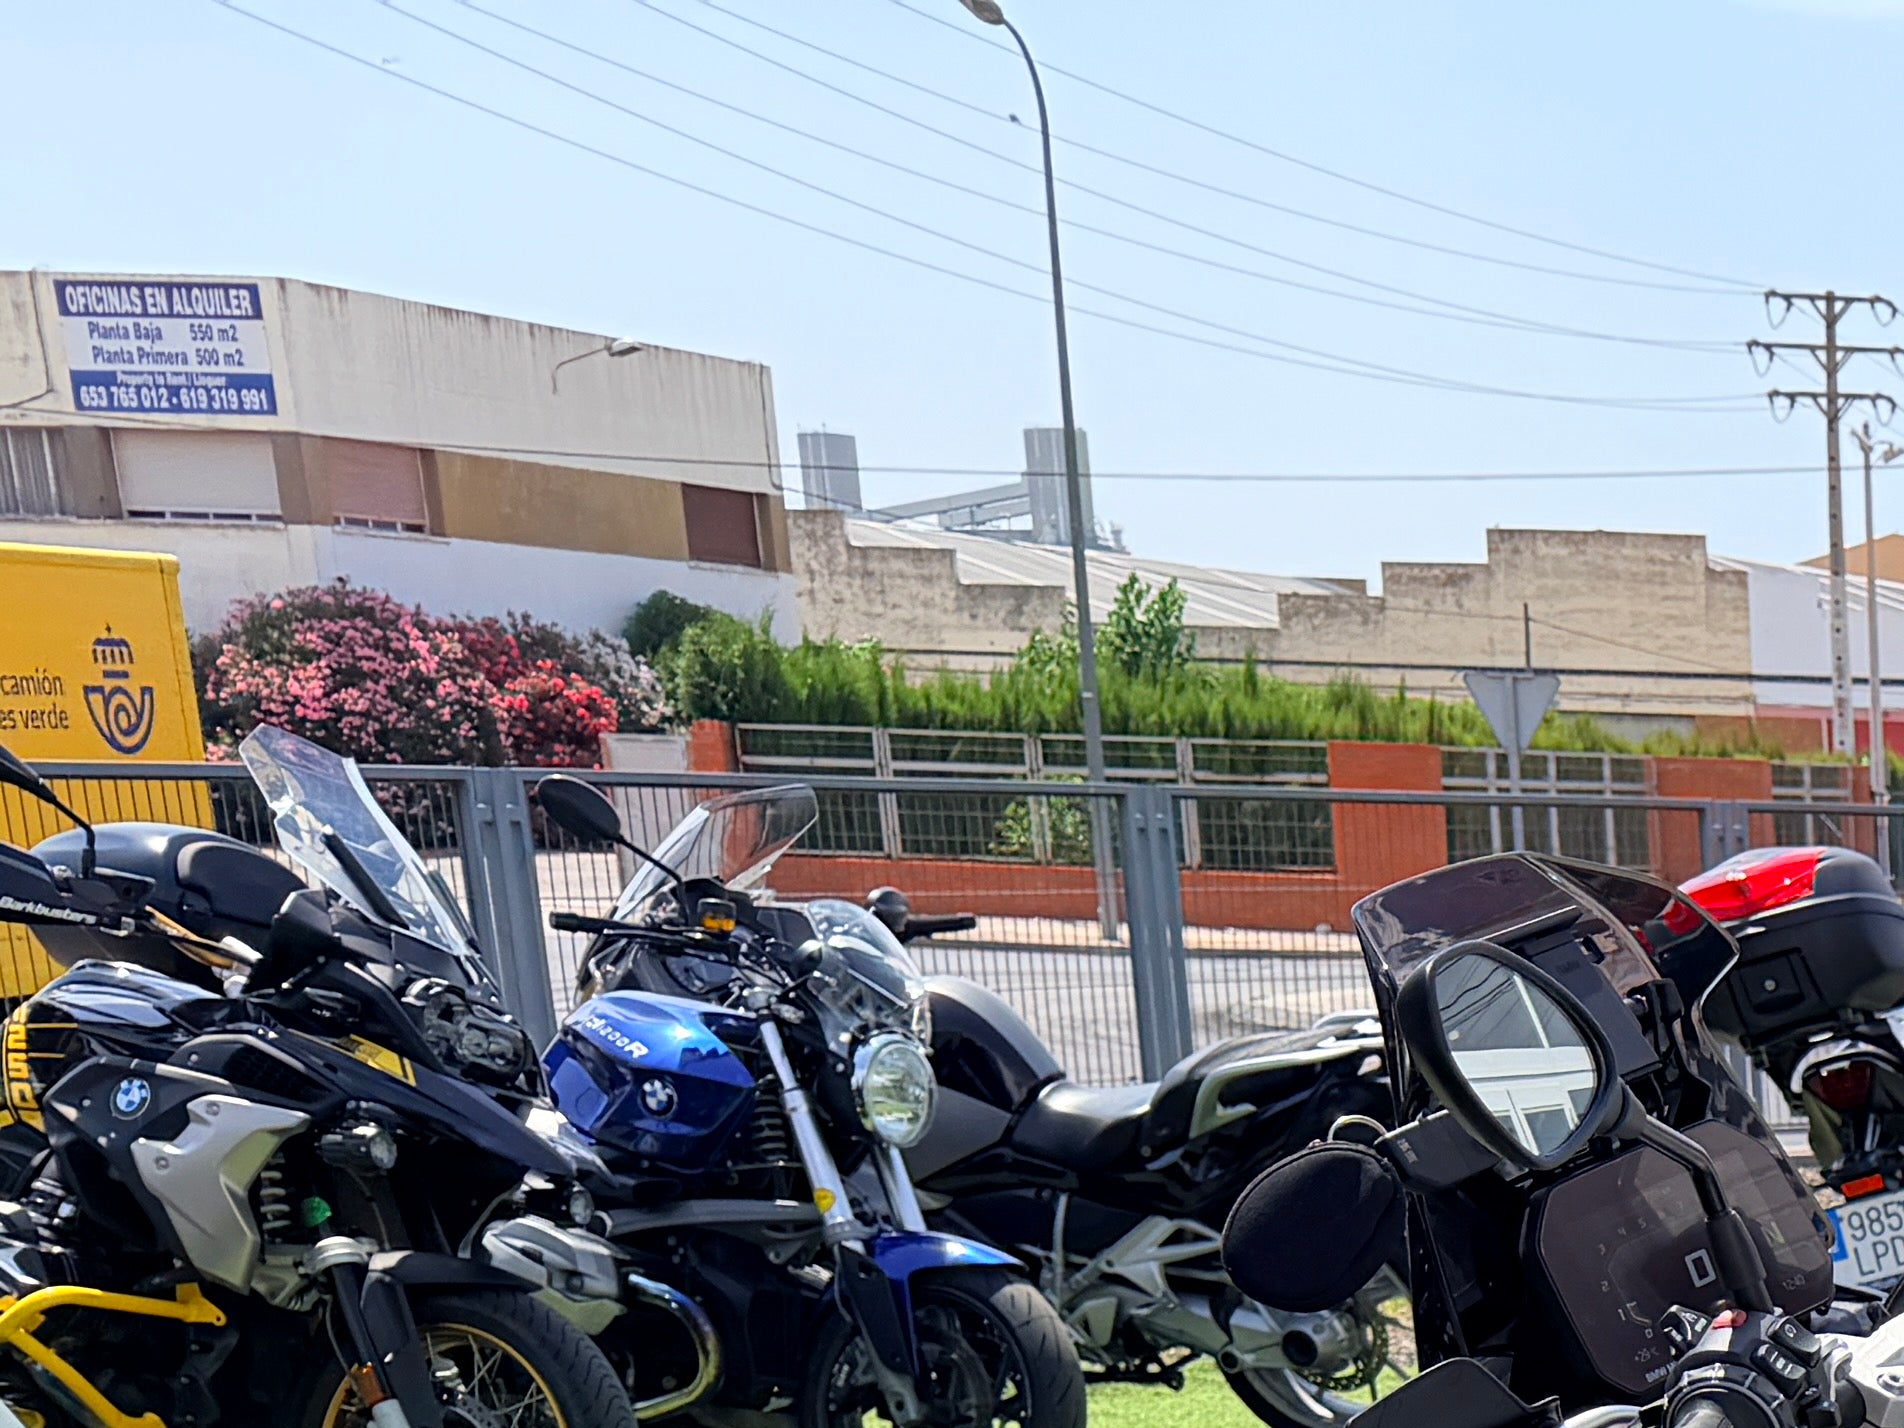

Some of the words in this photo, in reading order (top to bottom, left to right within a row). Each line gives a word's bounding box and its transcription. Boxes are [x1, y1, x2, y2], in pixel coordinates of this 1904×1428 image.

[65, 285, 143, 315] OFICINAS
[144, 287, 169, 315] EN
[173, 287, 253, 316] ALQUILER
[88, 321, 130, 341] Planta
[133, 322, 163, 346] Baja
[189, 324, 214, 342] 550
[217, 325, 239, 343] m2
[92, 346, 134, 365] Planta
[137, 346, 188, 367] Primera
[196, 348, 219, 367] 500
[223, 348, 245, 367] m2
[79, 385, 108, 408] 653
[110, 386, 136, 408] 765
[141, 386, 170, 409] 012
[179, 388, 208, 410] 619
[210, 388, 238, 411] 319
[241, 388, 268, 411] 991
[0, 668, 64, 697] camión
[19, 703, 69, 730] verde
